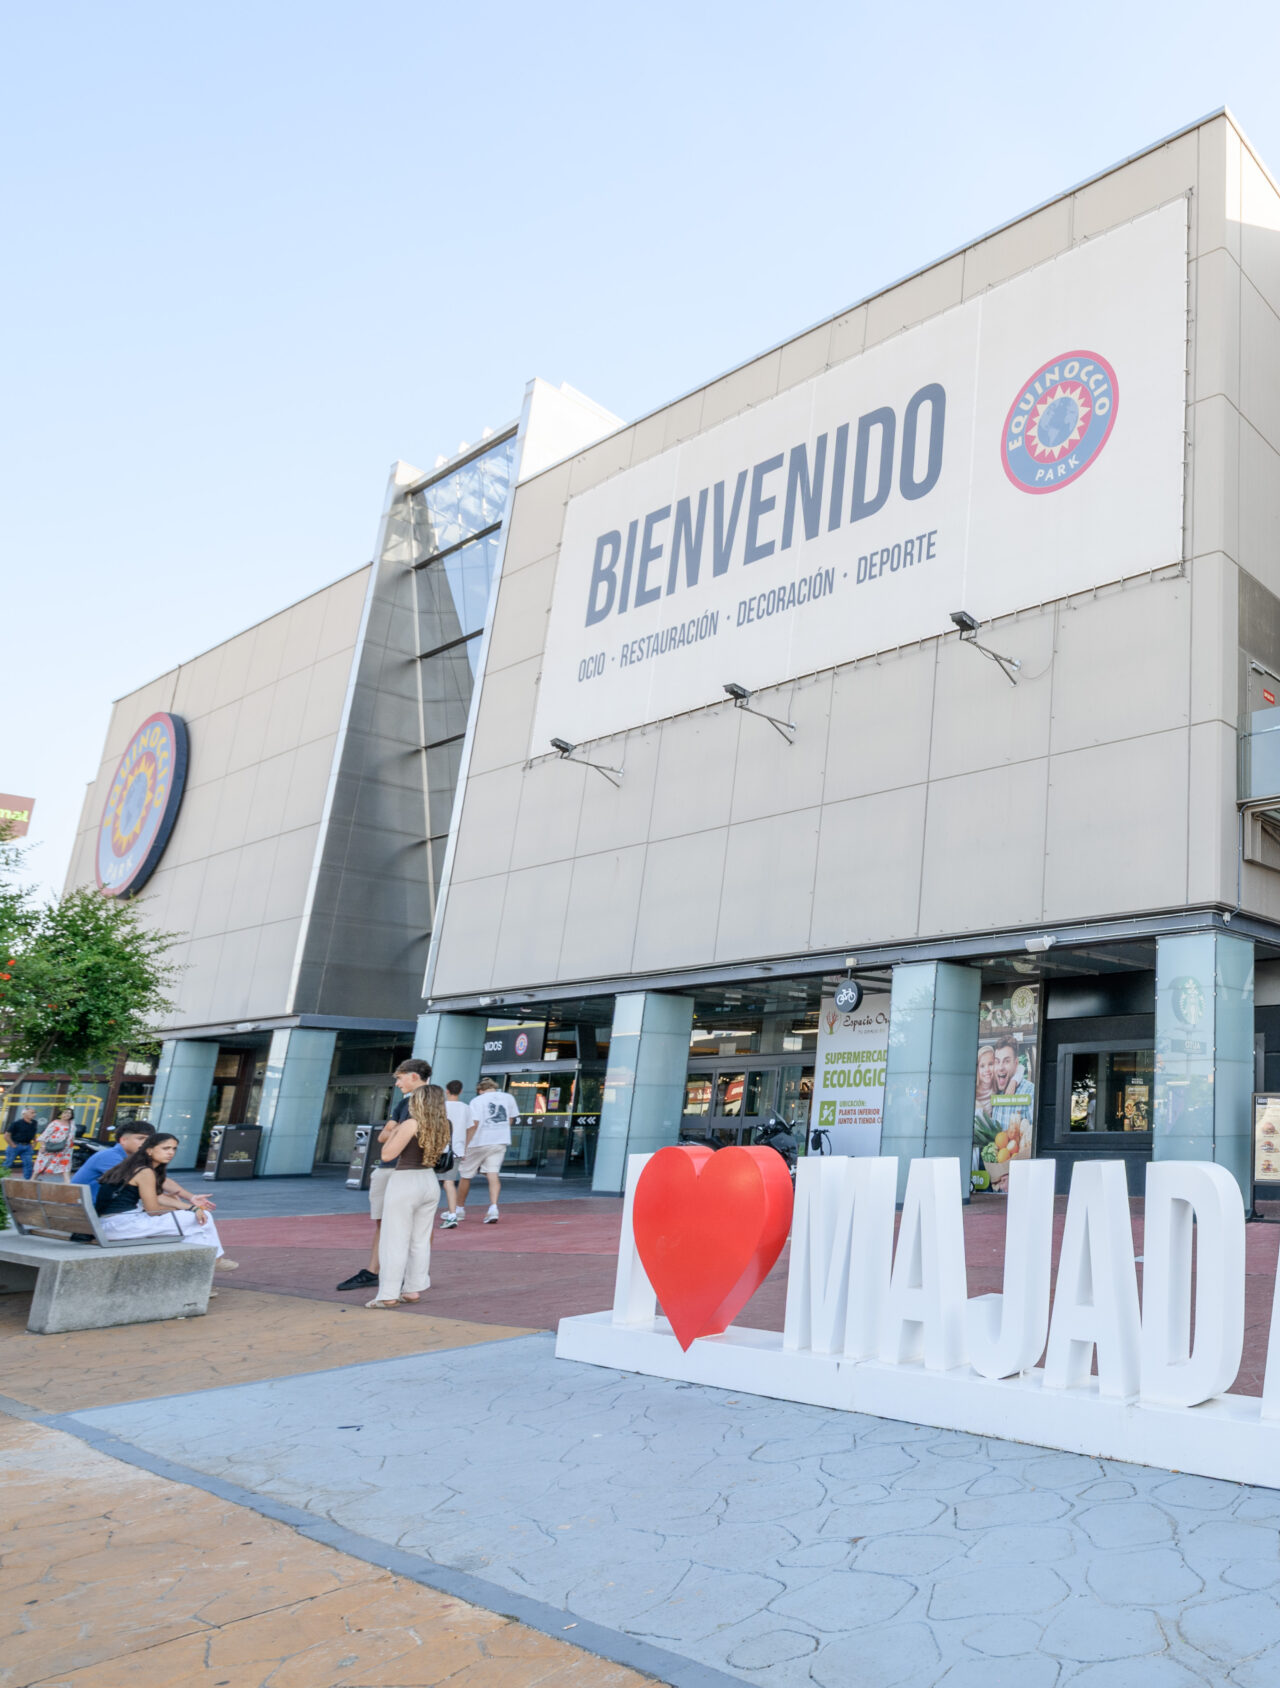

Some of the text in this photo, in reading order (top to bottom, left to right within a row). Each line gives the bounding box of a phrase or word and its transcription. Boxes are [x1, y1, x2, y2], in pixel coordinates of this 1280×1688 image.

[1008, 361, 1110, 451] EQUINOCCIO
[584, 382, 947, 628] BIENVENIDO
[1035, 454, 1080, 481] PARK
[577, 530, 938, 683] OCIO RESTAURACIÓN DECORACIÓN DEPORTE
